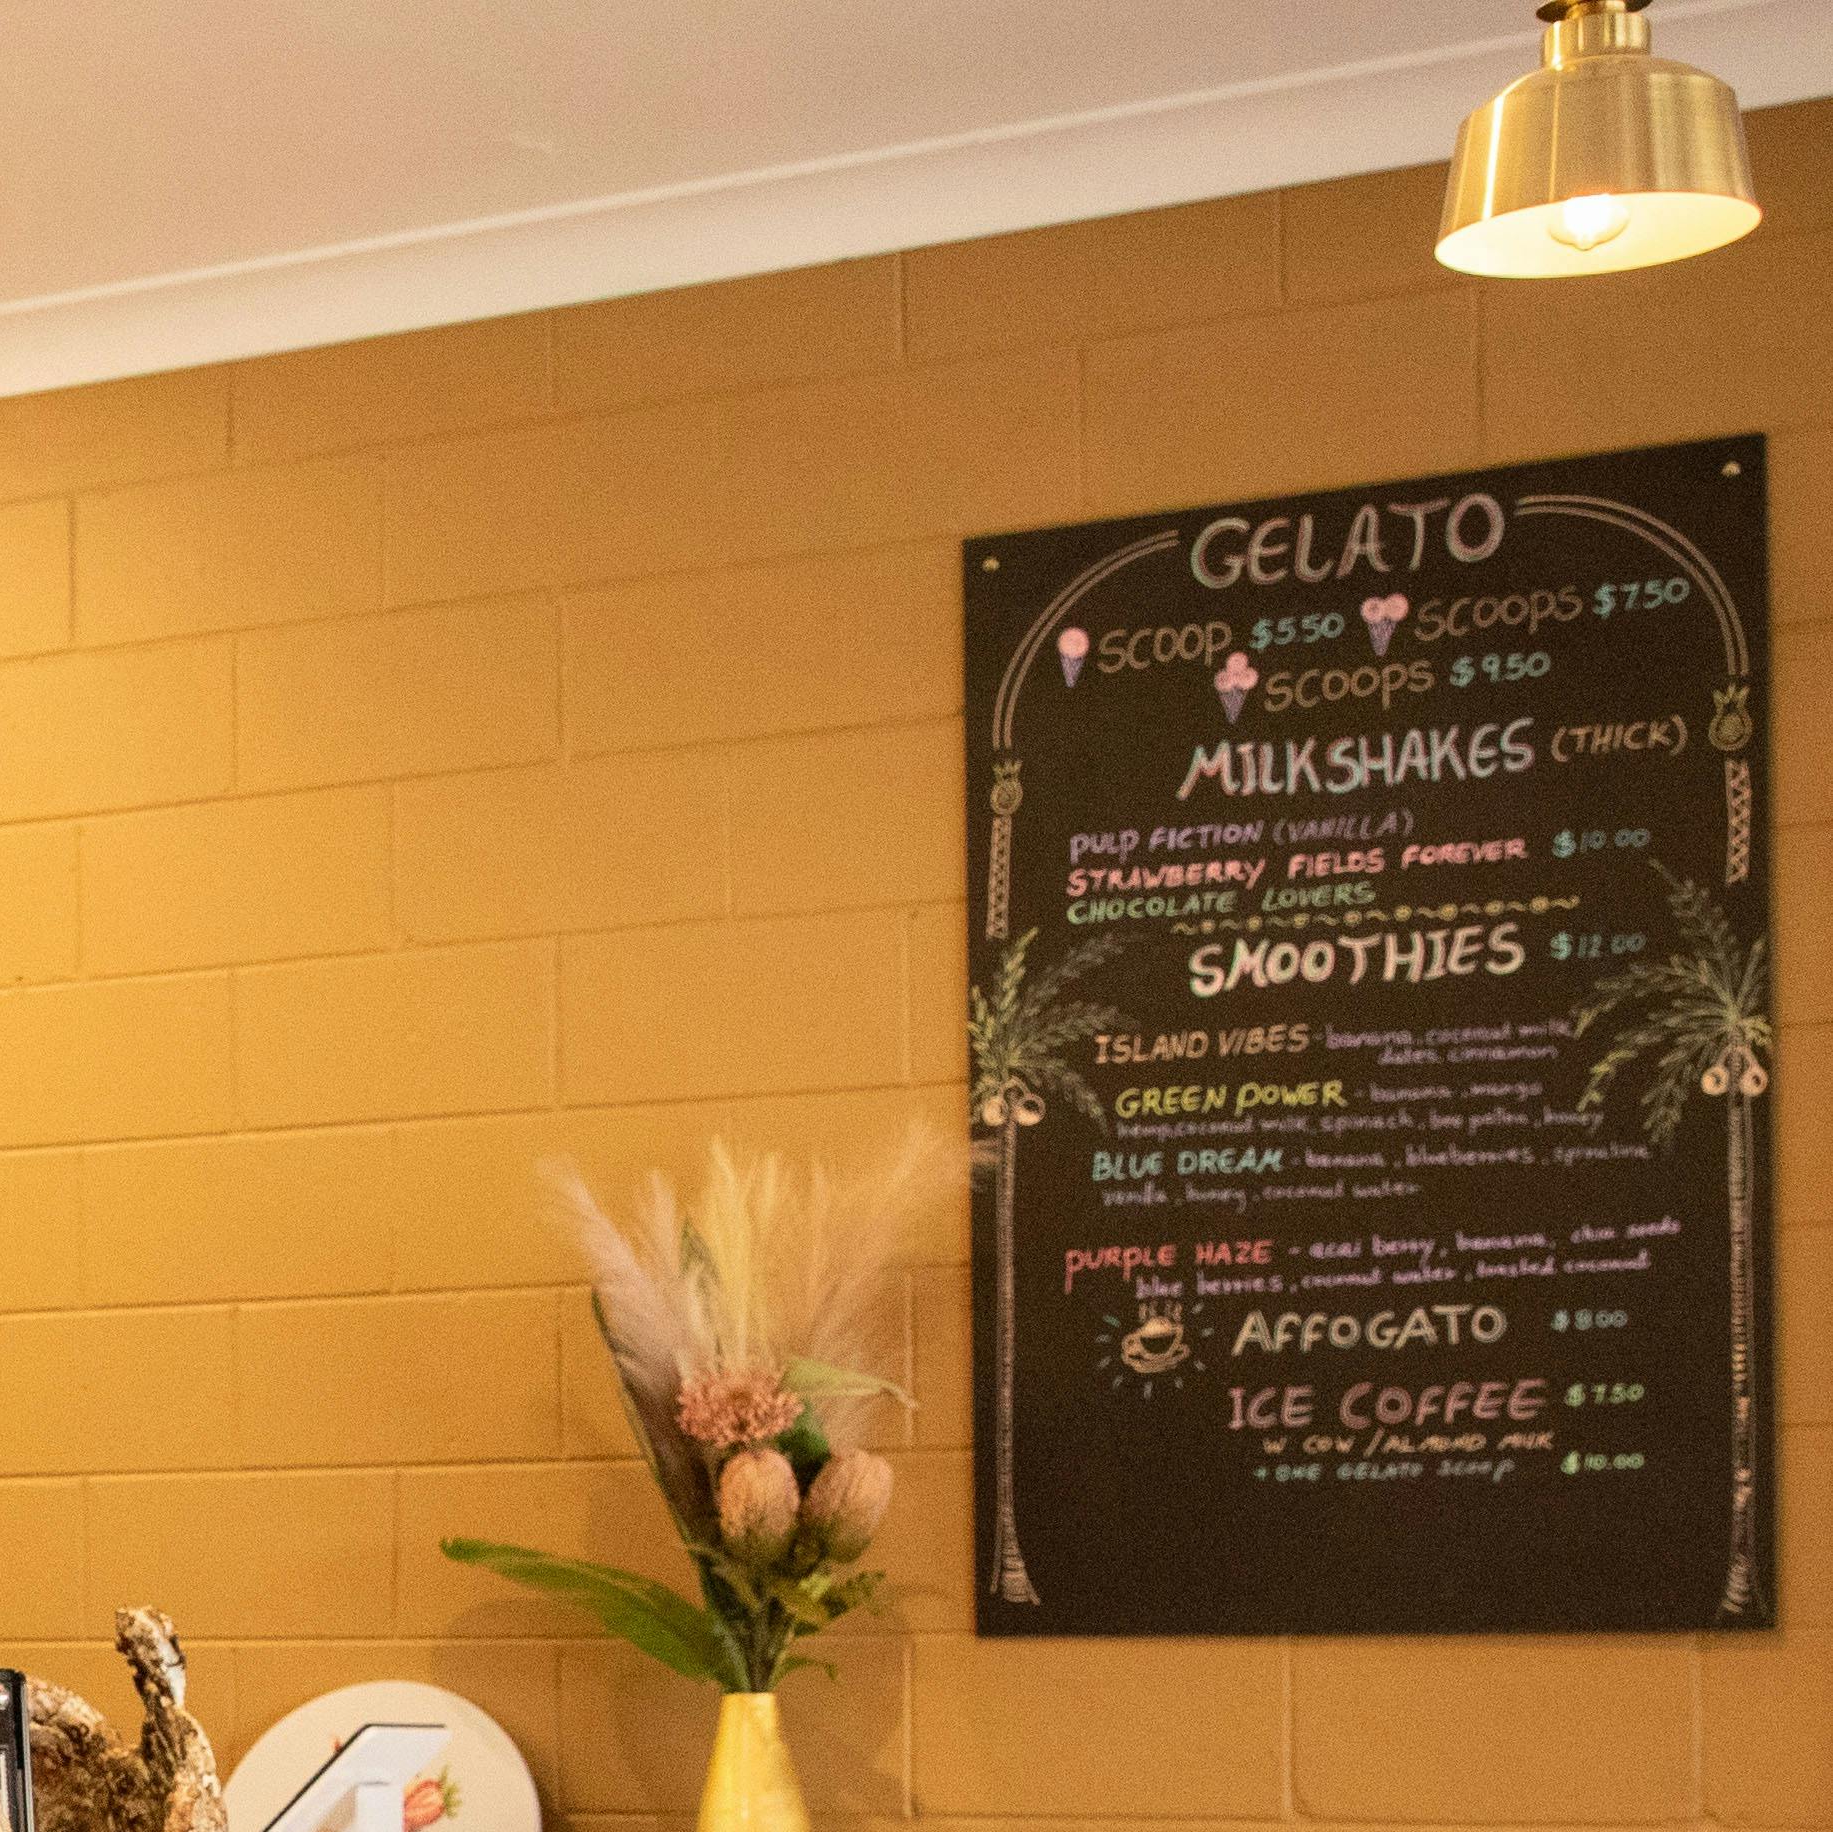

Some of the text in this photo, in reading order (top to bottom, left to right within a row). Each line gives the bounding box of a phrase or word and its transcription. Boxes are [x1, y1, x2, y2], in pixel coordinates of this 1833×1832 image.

[1190, 493, 1506, 589] GELATO
[1414, 584, 1583, 641] SCOOPS
[1096, 620, 1233, 674] SCOOP
[1264, 659, 1435, 711] SCOOPS
[1177, 714, 1688, 800] MILKSHAKES (THICK)
[1069, 808, 1415, 865] PULP FICTION (VANILLA)
[1066, 838, 1529, 897] STRAWBERRY FIELDS FOREVER
[1066, 881, 1377, 925] CHOCOLATE LOVERS
[1188, 922, 1527, 998] SMOOTHIES
[1094, 1030, 1210, 1064] ISLAND
[1219, 1022, 1311, 1058] VIBES
[1115, 1084, 1227, 1119] GREEN
[1236, 1078, 1348, 1118] POWER
[1092, 1150, 1165, 1182] BLUE
[1177, 1145, 1284, 1176] DREAM
[1064, 1243, 1178, 1295] PURPLE
[1195, 1238, 1274, 1266] HAZE
[1230, 1304, 1508, 1358] AFFOGATO
[1228, 1384, 1314, 1431] ICE
[1338, 1378, 1547, 1431] COFFEE
[1302, 1433, 1357, 1455] COW
[1335, 1460, 1424, 1482] GELATO
